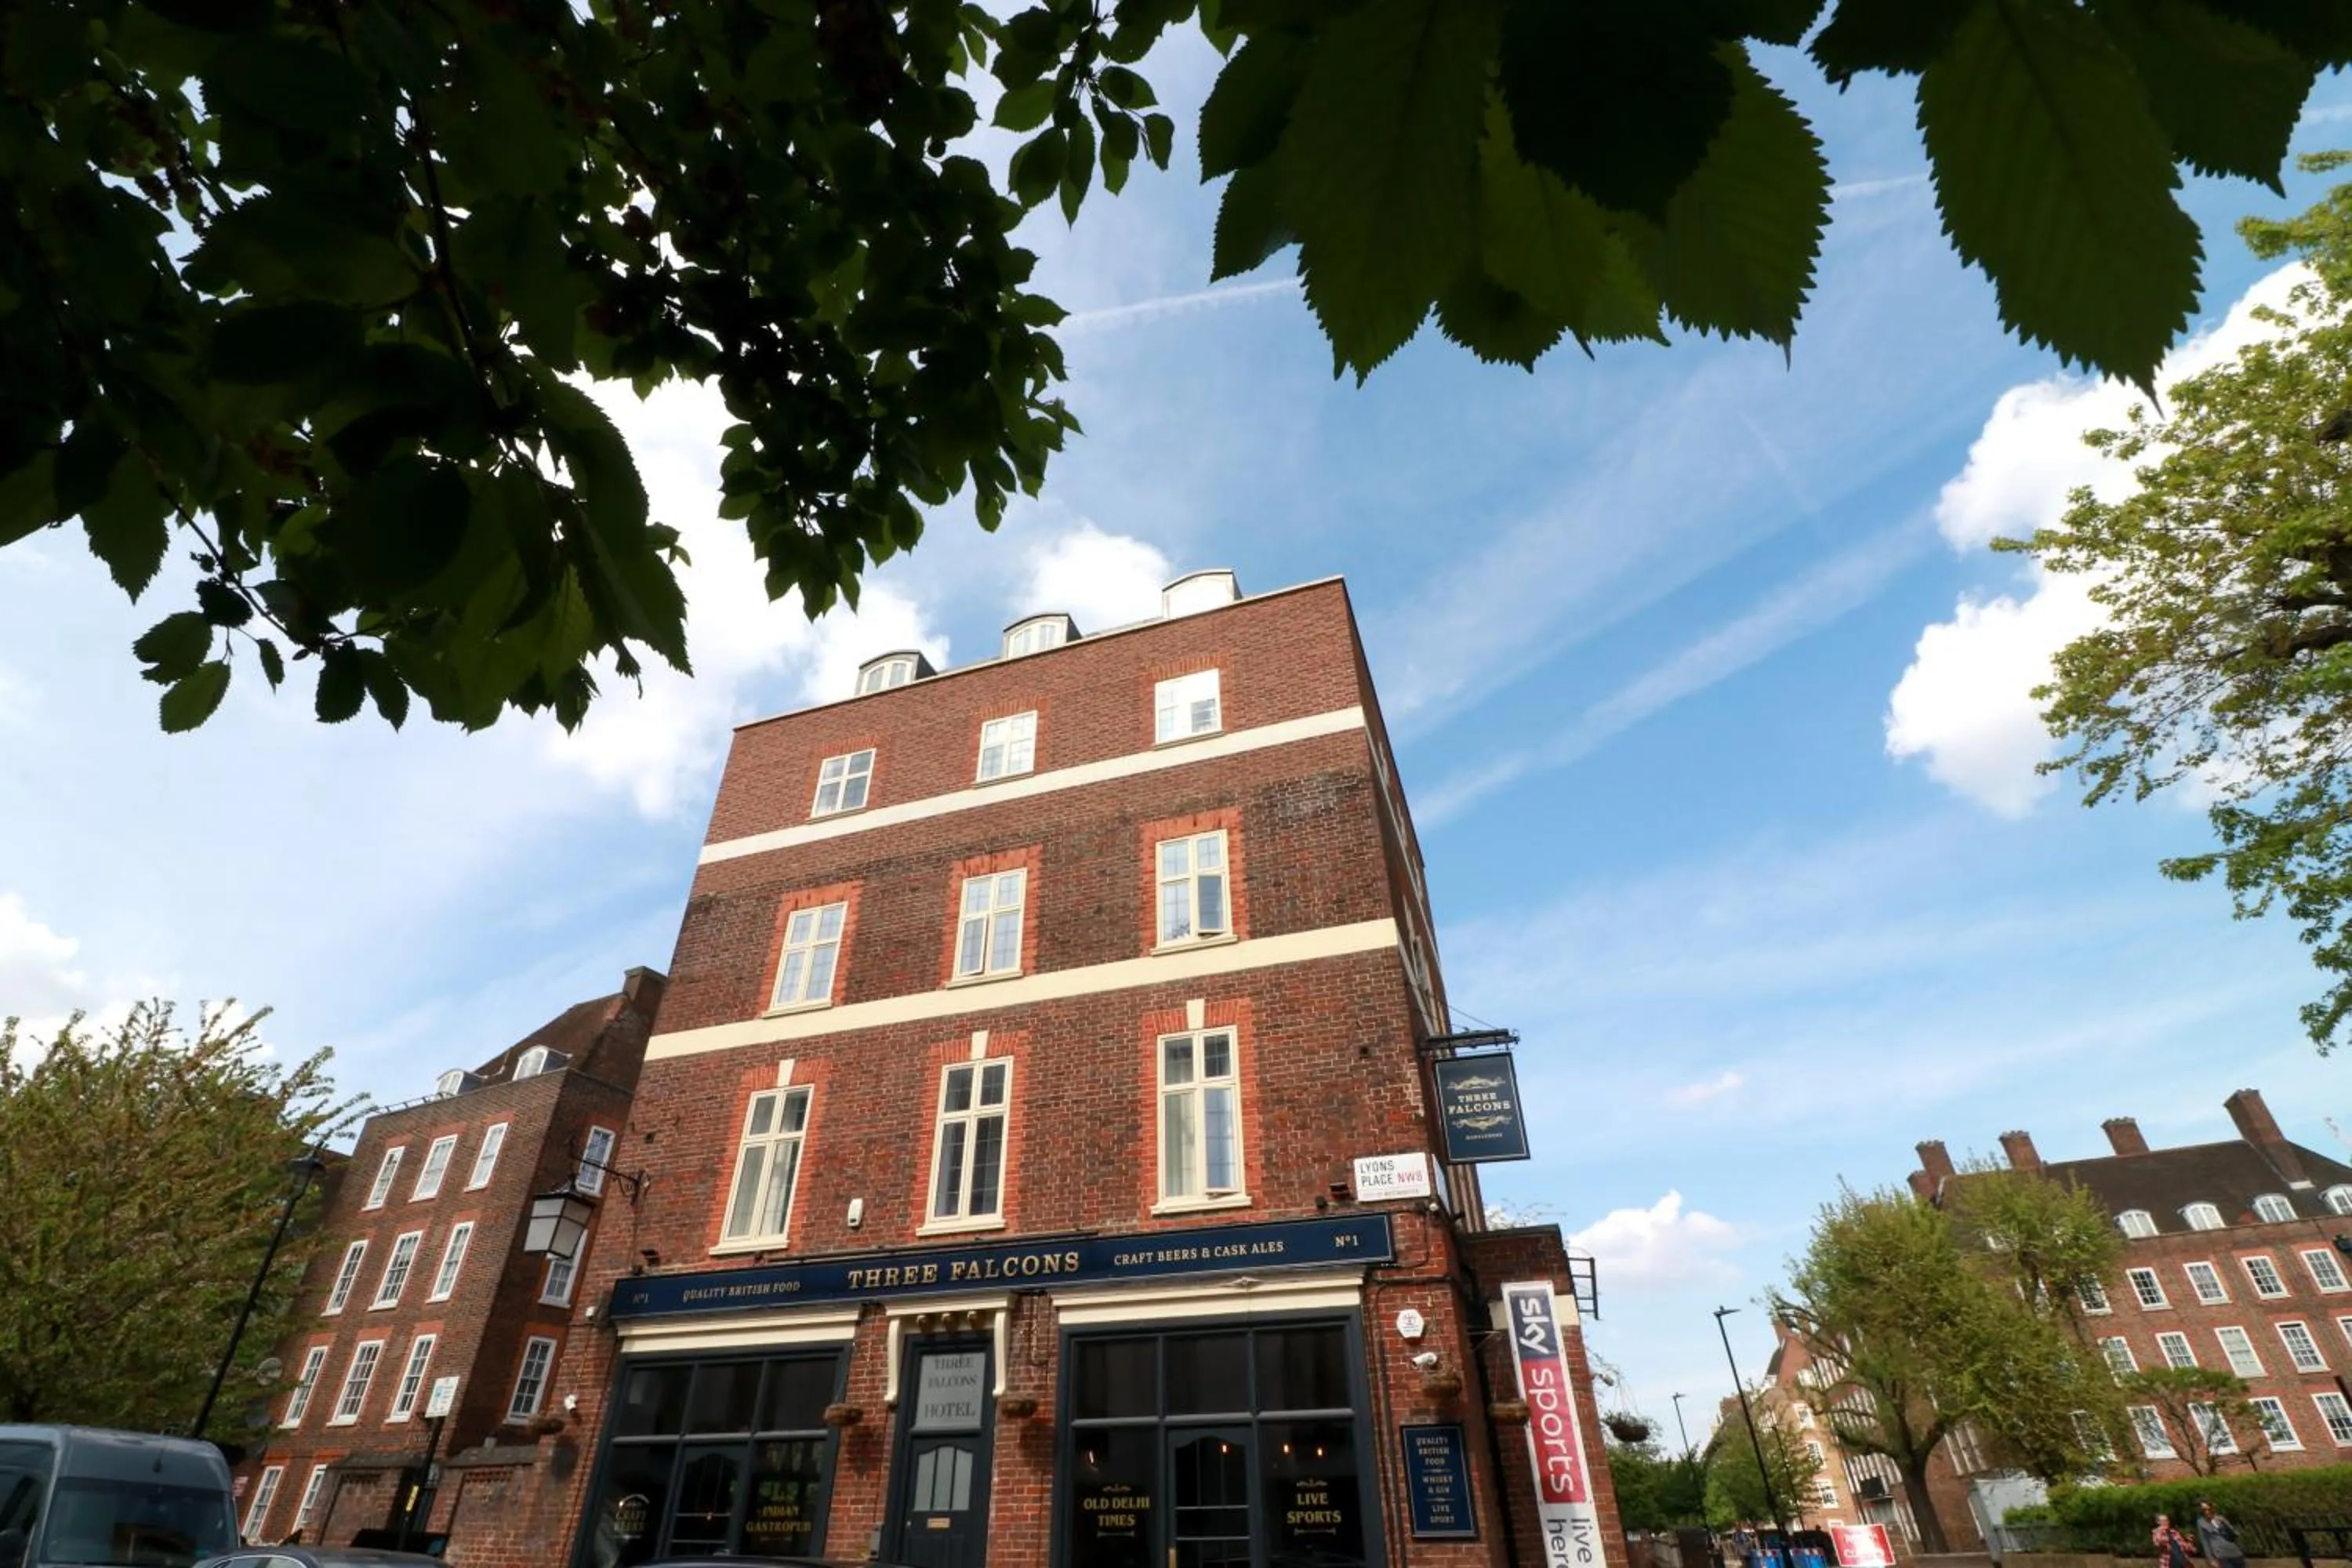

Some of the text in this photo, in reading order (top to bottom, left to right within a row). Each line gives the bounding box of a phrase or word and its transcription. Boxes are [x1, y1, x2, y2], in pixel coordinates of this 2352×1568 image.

[1457, 1093, 1497, 1103] THREE
[1448, 1100, 1512, 1114] FALCONS
[1359, 1160, 1395, 1174] LYONS
[1360, 1170, 1423, 1187] PLACE NW8
[683, 1287, 726, 1303] QUALITY
[728, 1283, 770, 1297] BRITISH
[772, 1280, 801, 1293] FOOD
[848, 1263, 938, 1290] THREE
[950, 1251, 1080, 1281] FALCONS
[1113, 1251, 1154, 1267] CRAFT
[1157, 1247, 1197, 1262] BEERS
[1201, 1246, 1211, 1258] &
[1214, 1243, 1248, 1258] CASK
[1250, 1240, 1285, 1254] ALES
[1519, 1298, 1550, 1355] sky
[934, 1356, 975, 1370] THREE
[927, 1374, 978, 1389] FALCONS
[924, 1402, 976, 1418] HOTEL
[1528, 1367, 1573, 1494] sports
[1416, 1436, 1448, 1446] QUALITY
[1425, 1457, 1446, 1465] FOOD
[1083, 1496, 1151, 1510] OLD DELHI
[1296, 1492, 1329, 1505] LIVE
[762, 1504, 800, 1517] INDIAN
[1432, 1504, 1450, 1513] LIVE
[1097, 1513, 1136, 1527] TIMES
[1286, 1510, 1342, 1524] SPORTS
[1429, 1515, 1455, 1524] SPORT
[745, 1520, 812, 1533] GASTROPUB
[1570, 1518, 1593, 1563] live
